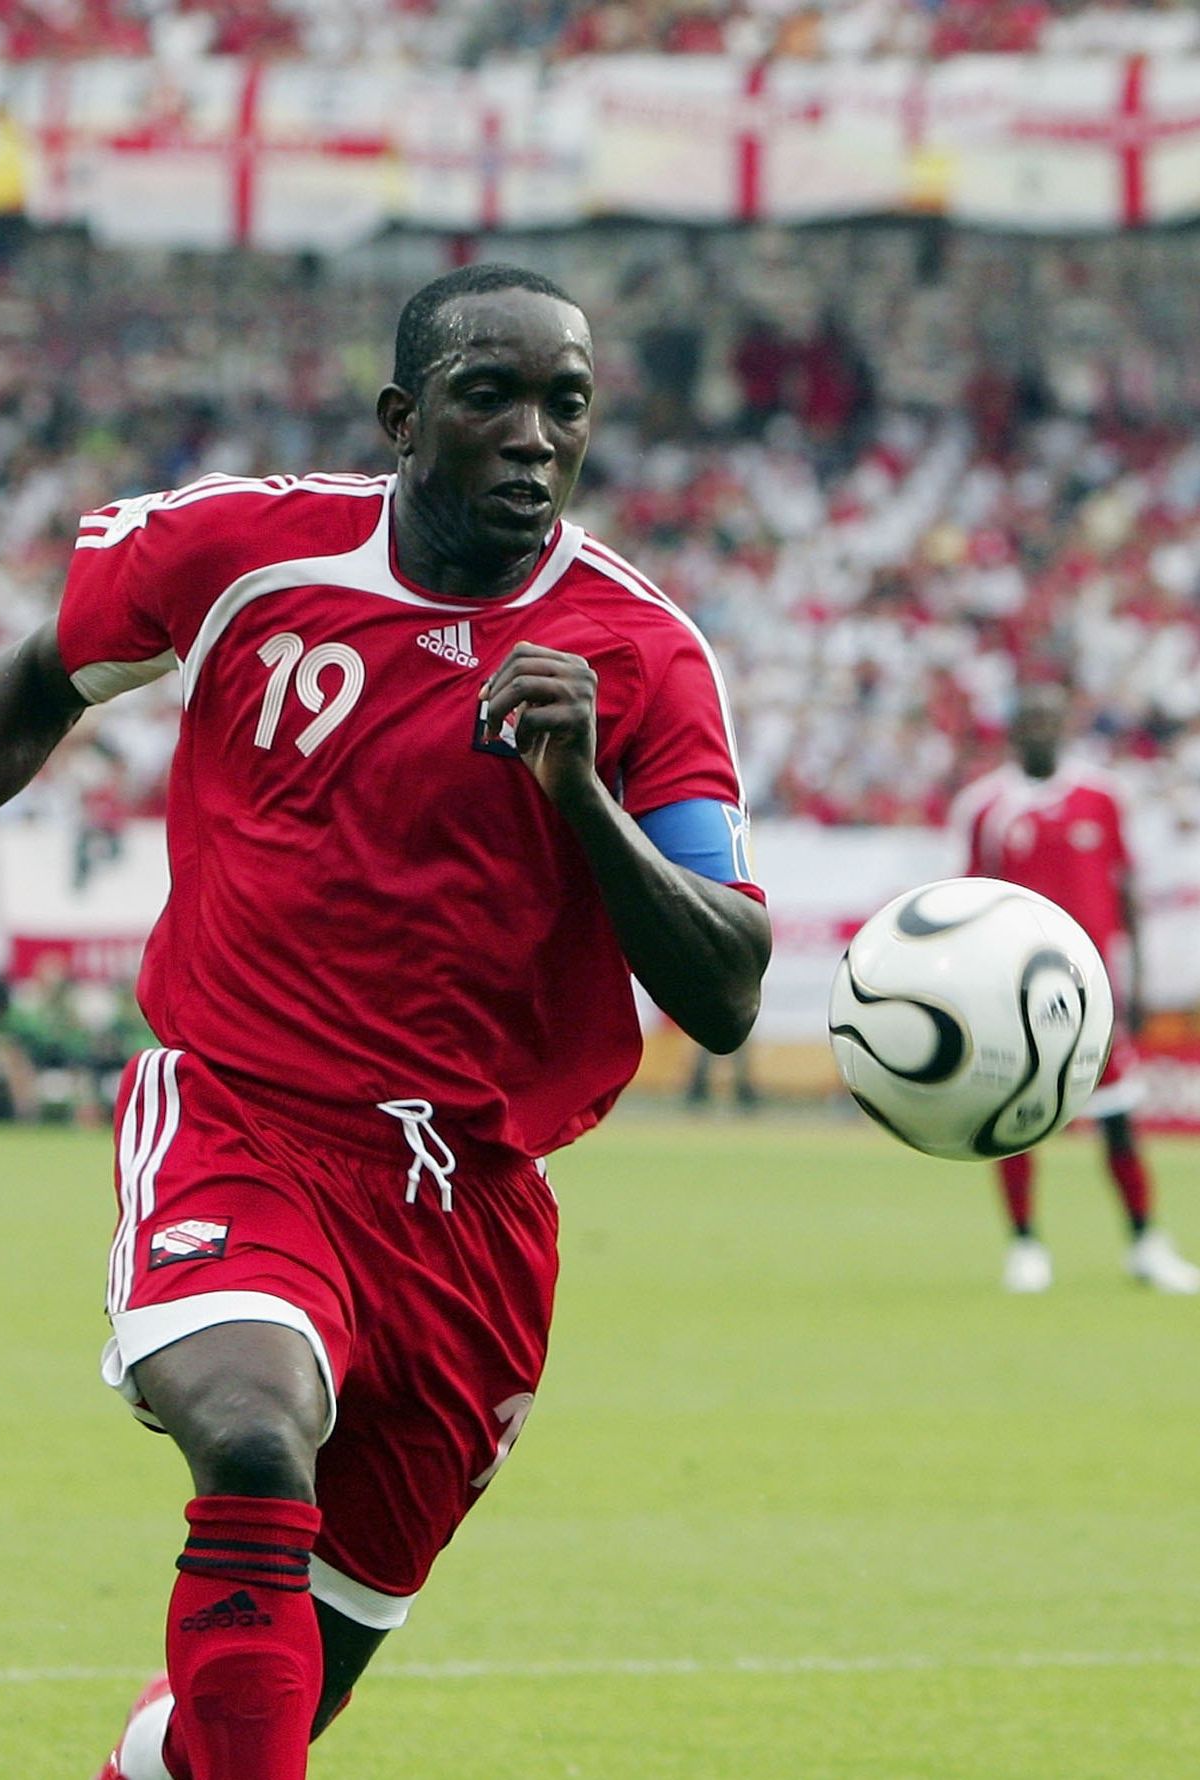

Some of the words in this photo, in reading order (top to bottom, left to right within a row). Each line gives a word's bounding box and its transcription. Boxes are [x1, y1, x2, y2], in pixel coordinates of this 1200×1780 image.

[416, 633, 480, 669] adidas
[254, 631, 365, 758] 19
[180, 1607, 273, 1632] adidas
